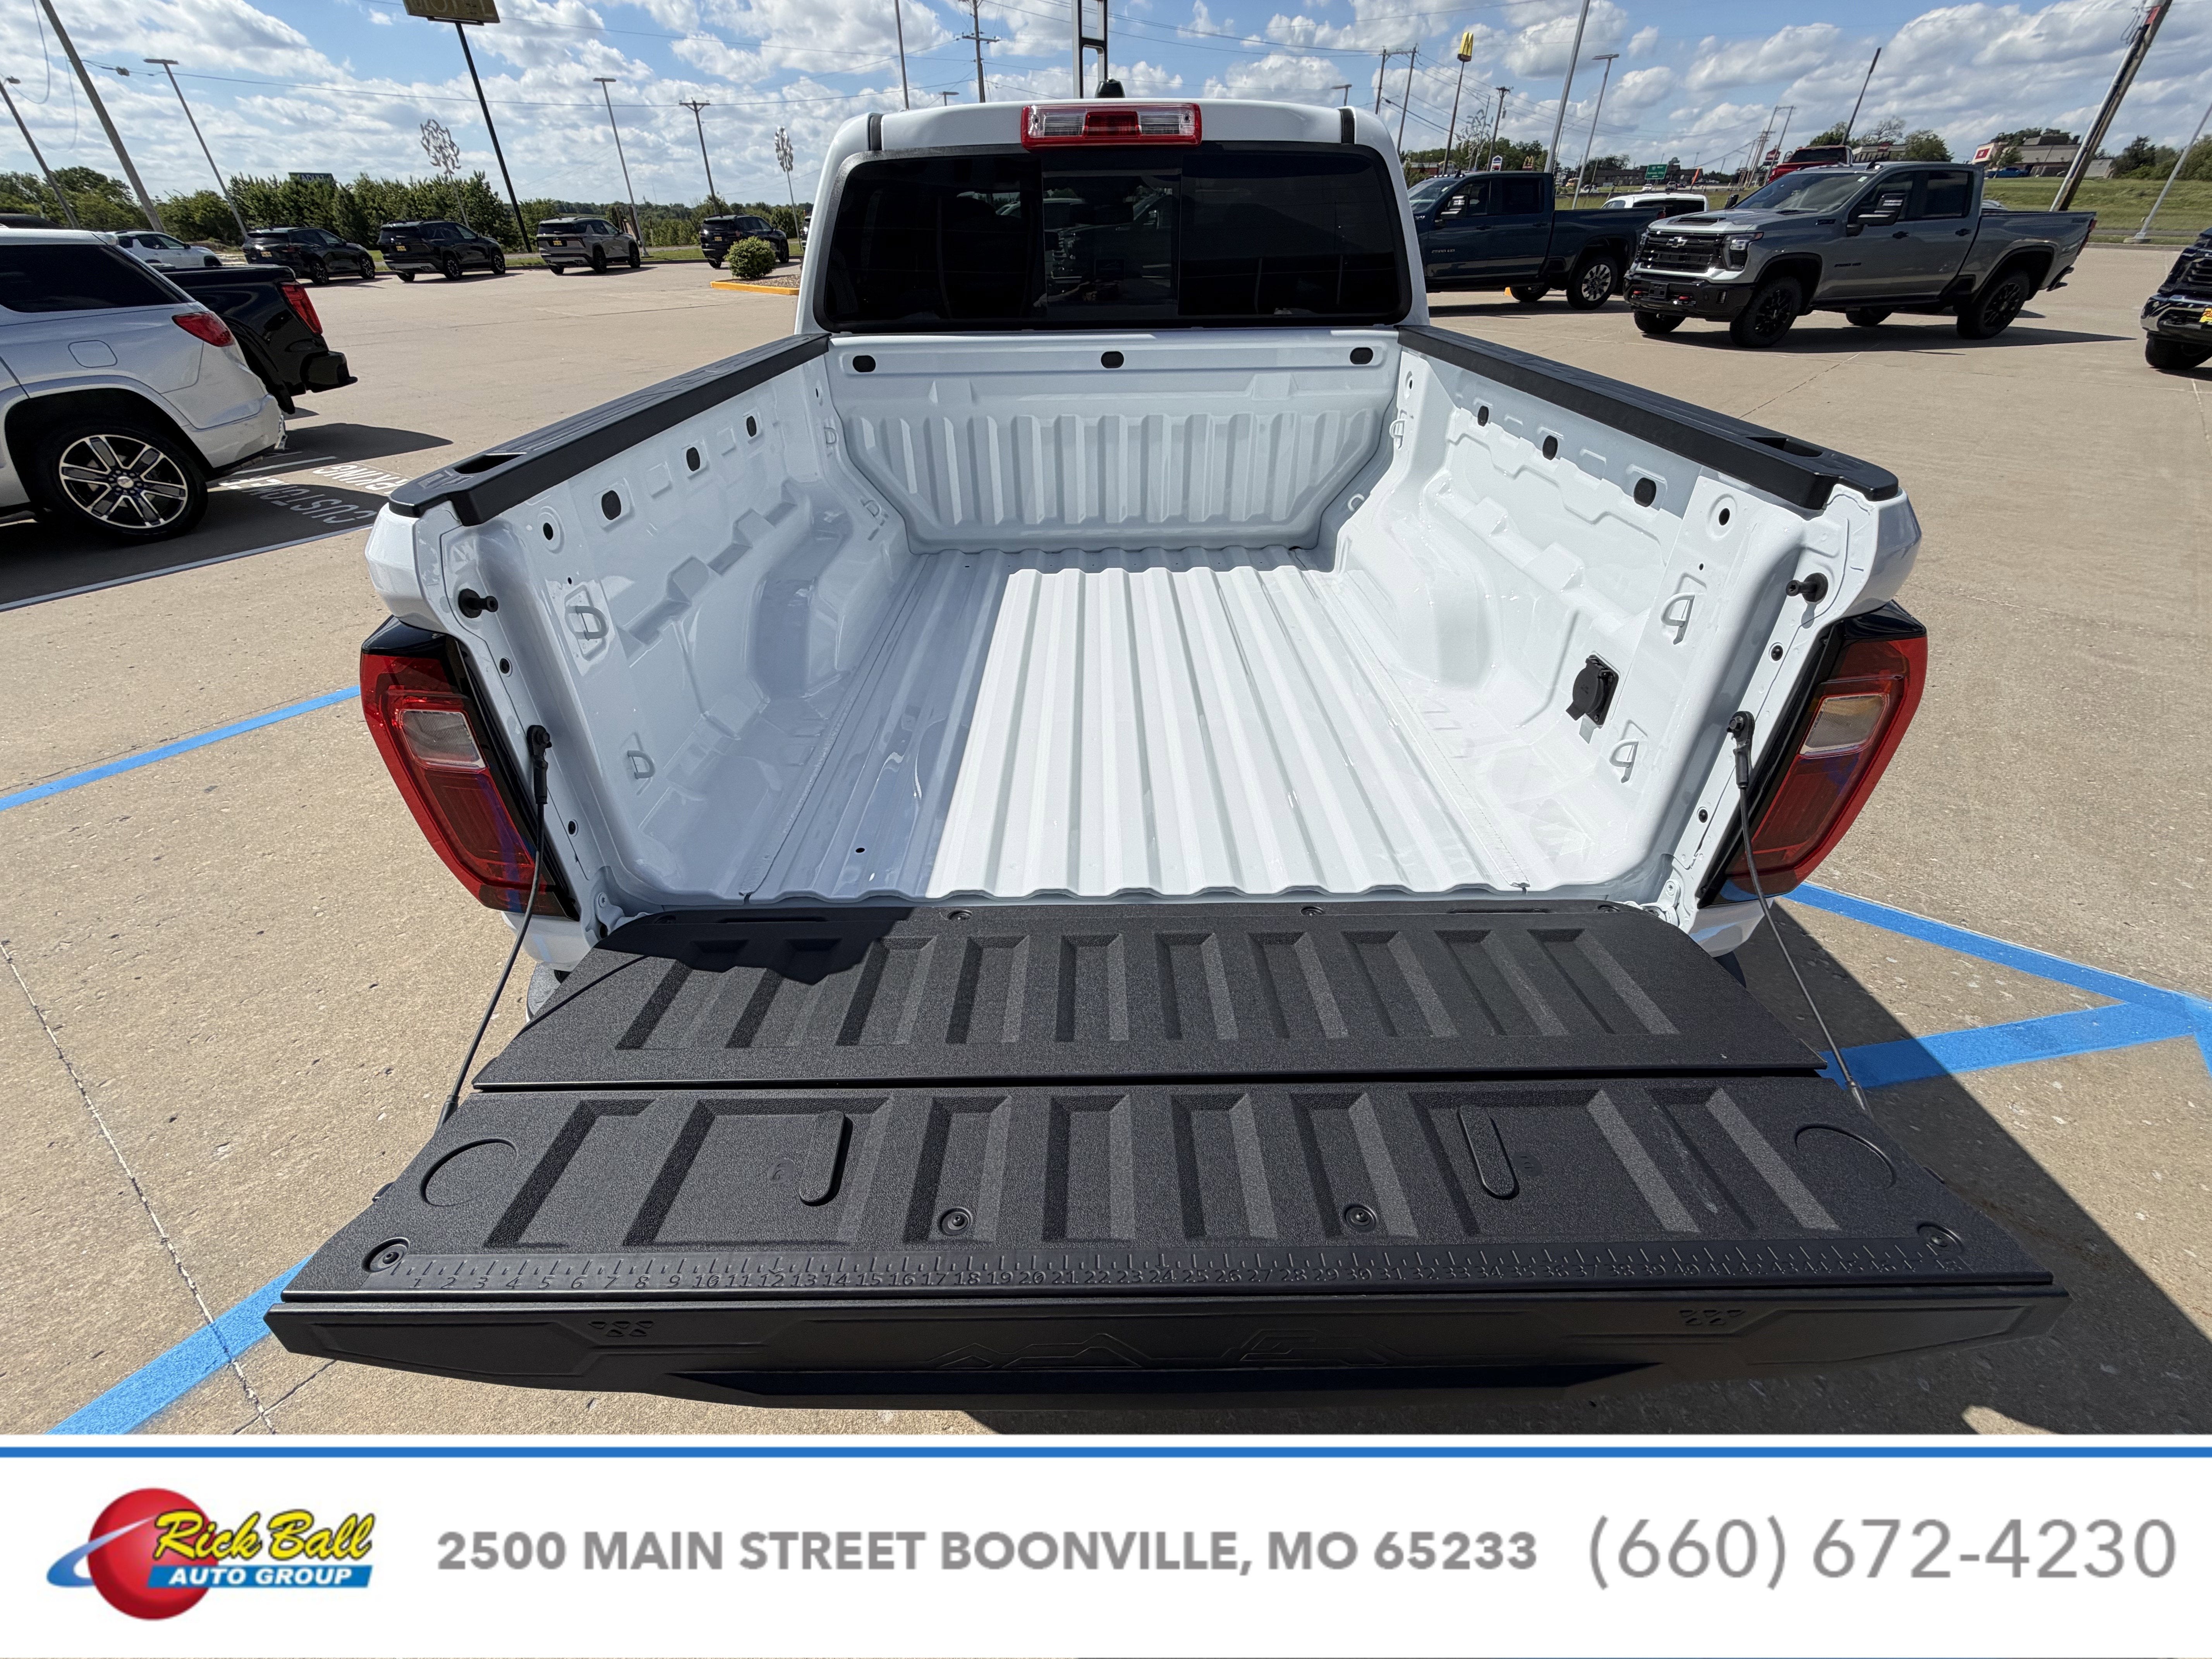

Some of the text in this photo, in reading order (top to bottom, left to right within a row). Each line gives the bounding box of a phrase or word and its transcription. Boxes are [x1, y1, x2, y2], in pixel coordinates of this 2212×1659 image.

[313, 465, 409, 495] RKING
[218, 476, 377, 524] CUSTOMER
[409, 1276, 424, 1289] 1
[440, 1276, 458, 1289] 2
[473, 1276, 489, 1289] 3
[506, 1276, 521, 1289] 4
[538, 1275, 555, 1289] 5
[571, 1274, 588, 1289] 6
[604, 1274, 620, 1289] 7
[635, 1274, 652, 1289] 8
[667, 1274, 682, 1288] 9
[692, 1274, 722, 1288] 10
[725, 1273, 753, 1288] 11
[757, 1273, 786, 1287] 12
[790, 1273, 819, 1287] 13
[823, 1273, 851, 1287] 14
[855, 1272, 884, 1286] 15
[888, 1272, 916, 1286] 16
[921, 1272, 949, 1285] 17
[954, 1271, 981, 1285] 18
[987, 1271, 1013, 1285] 19
[1019, 1271, 1046, 1285] 20
[1052, 1270, 1079, 1284] 21
[1085, 1270, 1111, 1284] 22
[1117, 1270, 1144, 1283] 23
[1149, 1269, 1177, 1283] 24
[1182, 1269, 1209, 1283] 25
[1214, 1269, 1242, 1283] 26
[1247, 1269, 1273, 1282] 27
[1279, 1268, 1307, 1282] 28
[1312, 1268, 1339, 1281] 29
[1344, 1268, 1372, 1281] 30
[1377, 1267, 1407, 1280] 31
[1410, 1267, 1439, 1280] 32
[1442, 1266, 1471, 1279] 33
[1474, 1266, 1504, 1279] 34
[1509, 1265, 1537, 1278] 35
[1539, 1264, 1570, 1277] 36
[1571, 1264, 1598, 1277] 37
[1604, 1264, 1635, 1277] 38
[1637, 1264, 1666, 1277] 39
[1673, 1263, 1701, 1276] 40
[1707, 1262, 1736, 1276] 41
[1740, 1262, 1768, 1275] 42
